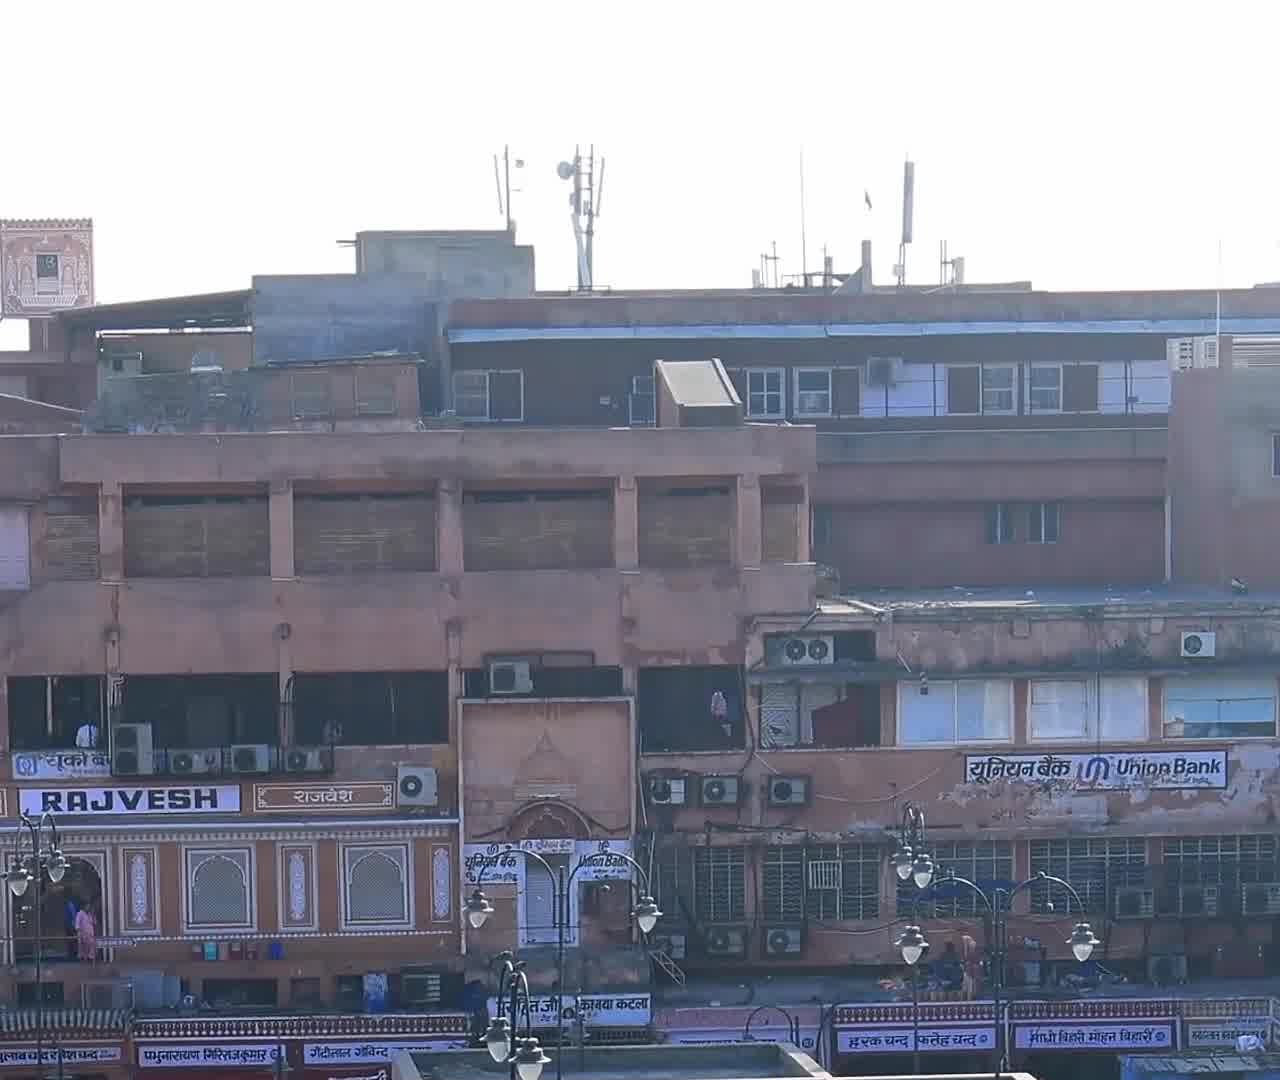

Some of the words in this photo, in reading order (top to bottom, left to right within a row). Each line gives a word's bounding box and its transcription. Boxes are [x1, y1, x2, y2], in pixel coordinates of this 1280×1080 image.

[969, 757, 1035, 781] यूनियन
[1037, 755, 1071, 777] बैंक
[1116, 758, 1172, 776] Union
[1173, 758, 1221, 776] Bank
[40, 785, 219, 813] RAJVESH
[292, 786, 354, 805] राजवेश
